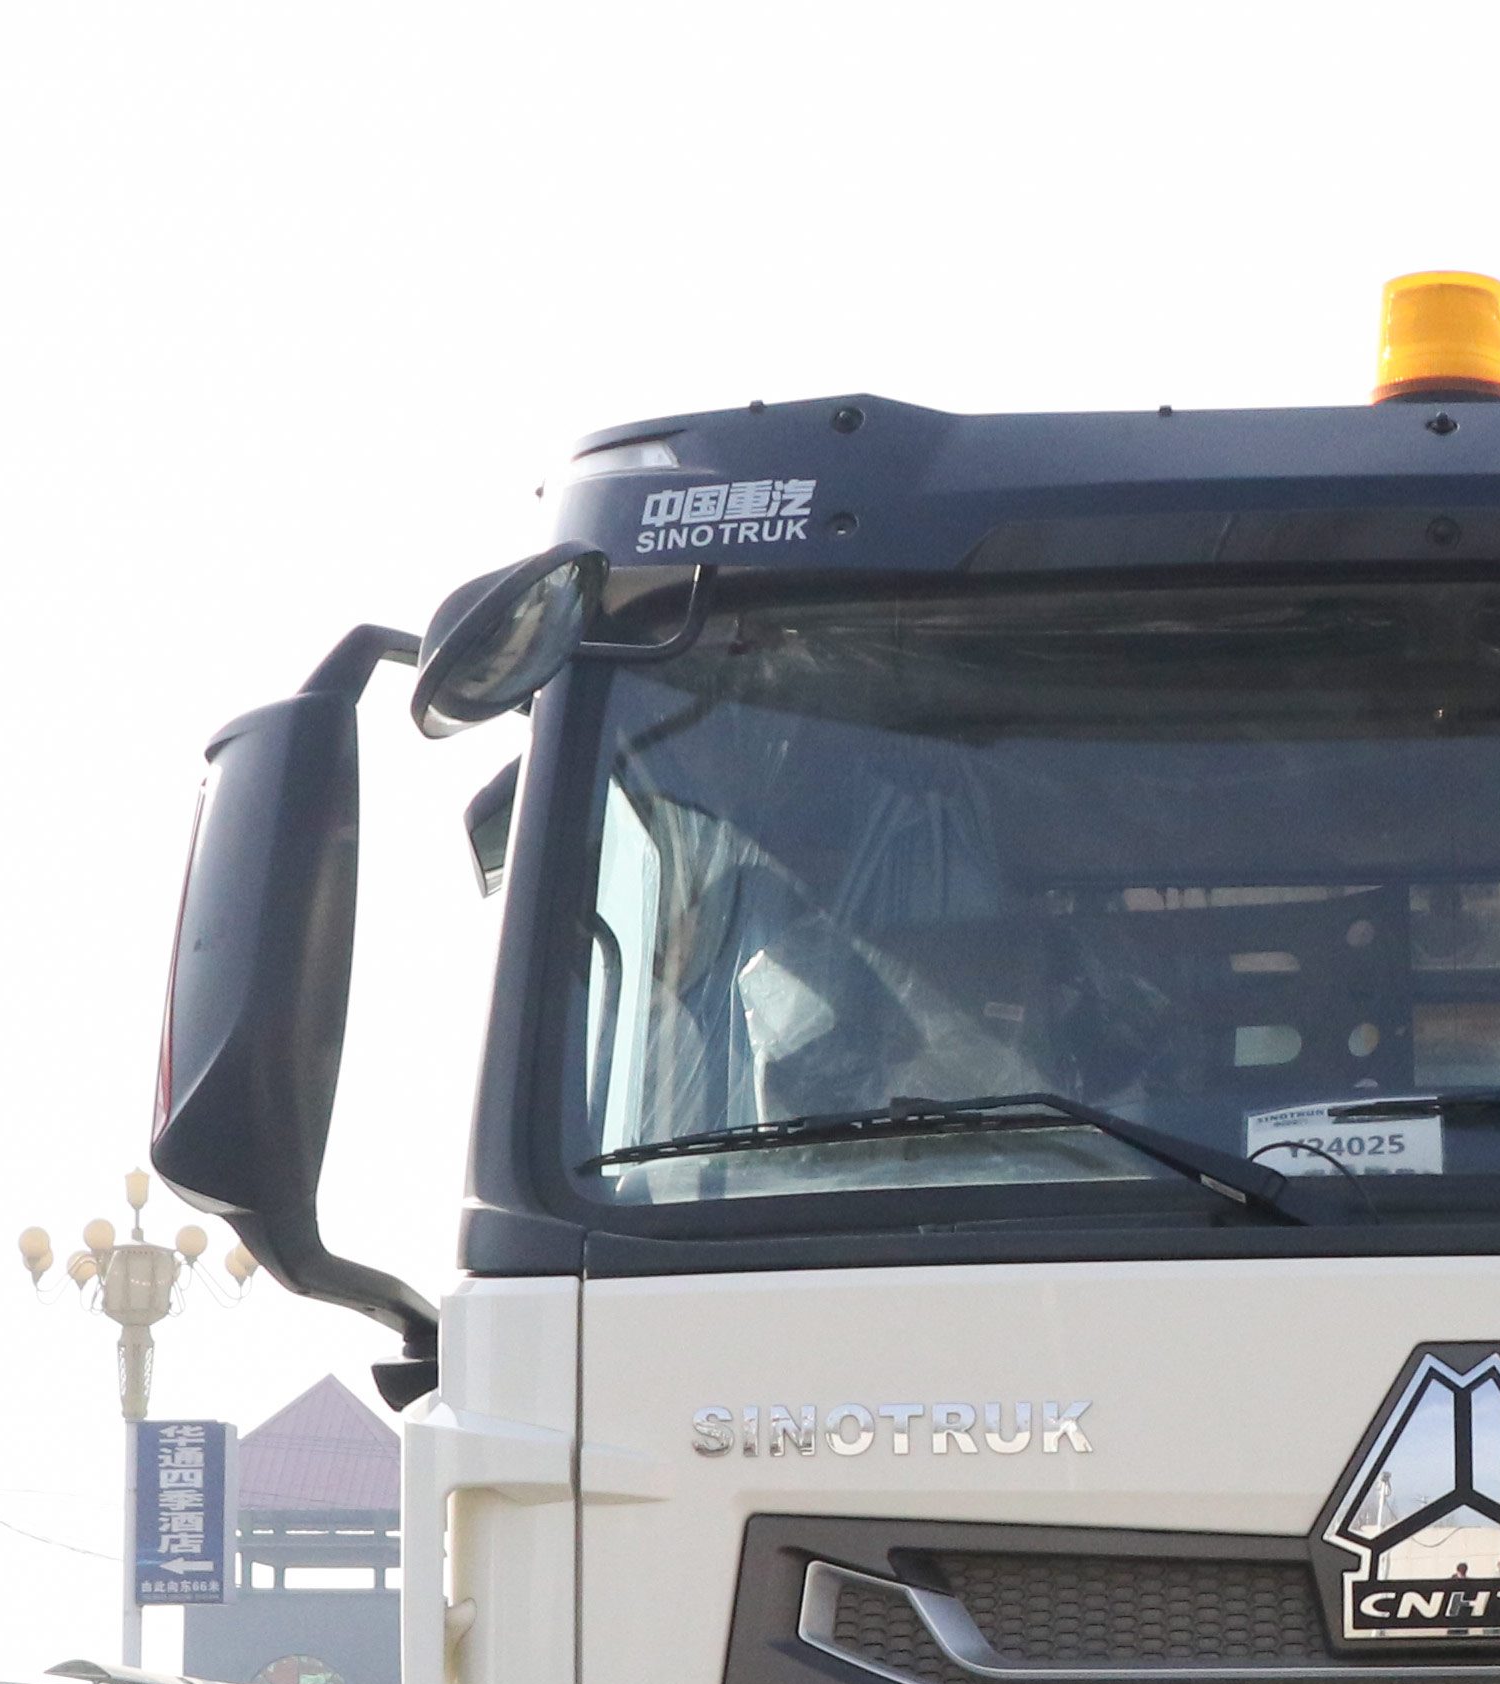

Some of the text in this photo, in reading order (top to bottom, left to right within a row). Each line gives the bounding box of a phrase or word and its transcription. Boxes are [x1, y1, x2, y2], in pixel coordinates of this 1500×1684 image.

[642, 479, 817, 527] 中国重汽
[636, 518, 809, 554] SINOTRUK
[692, 1400, 1094, 1458] SINOTRUK
[157, 1425, 206, 1554] 华通四季酒店
